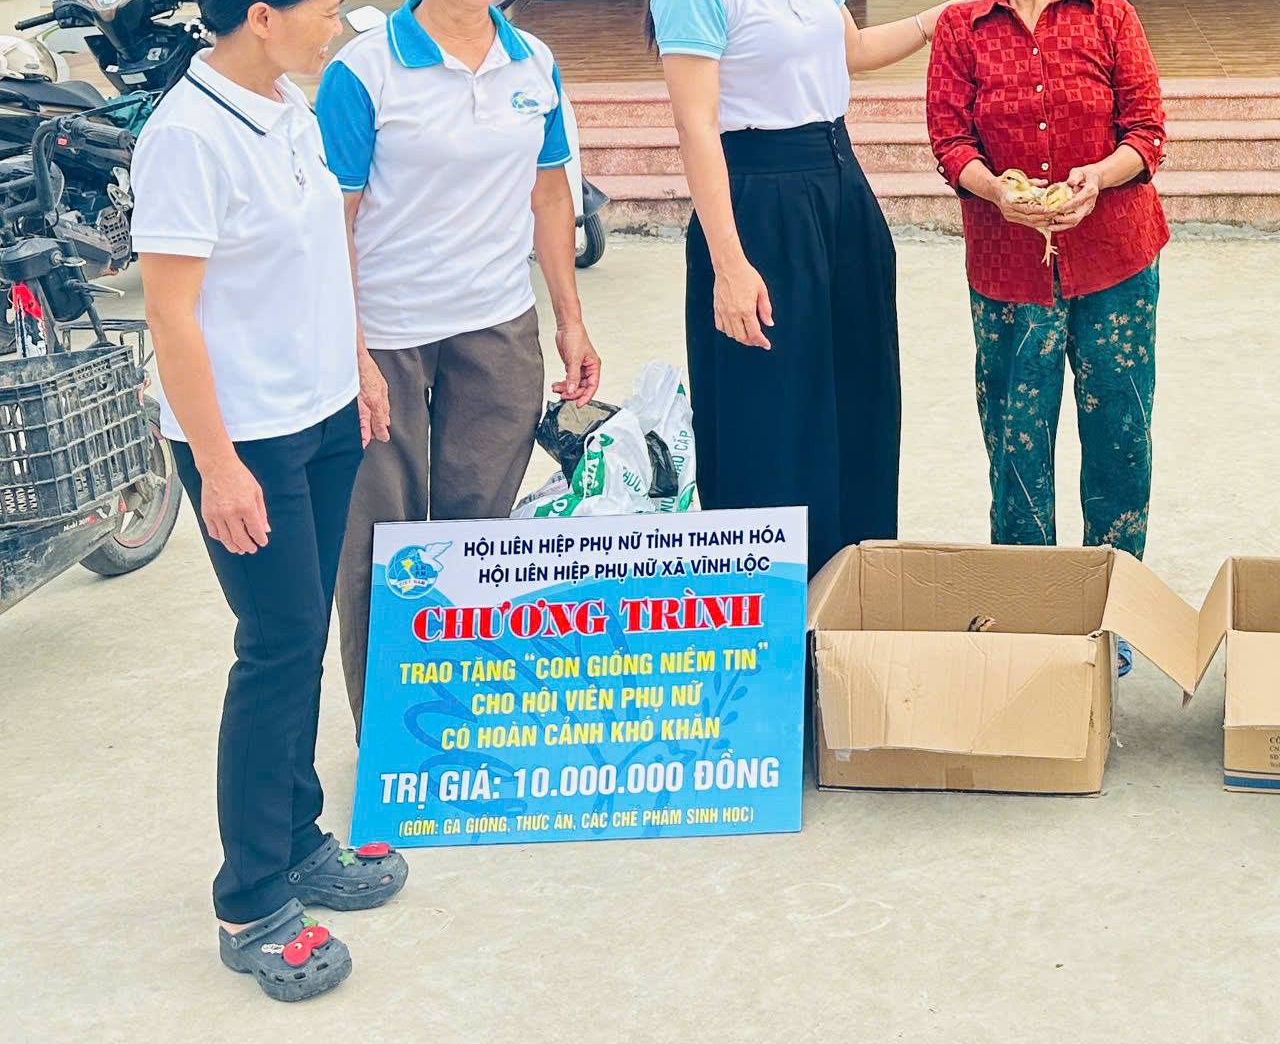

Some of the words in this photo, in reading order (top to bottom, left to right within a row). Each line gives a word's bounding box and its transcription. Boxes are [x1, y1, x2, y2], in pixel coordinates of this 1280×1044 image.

[464, 536, 495, 557] HỘI
[499, 535, 535, 555] LIÊN
[538, 533, 575, 557] HIỆP
[579, 535, 613, 556] PHỤ
[618, 531, 642, 551] NỮ
[646, 528, 683, 549] TỈNH
[688, 528, 745, 548] THANH
[749, 524, 786, 545] HÓA
[478, 563, 510, 588] HỘI
[515, 563, 549, 583] LIÊN
[553, 561, 590, 585] HIỆP
[594, 561, 629, 582] PHỤ
[633, 558, 658, 578] NỮ
[661, 557, 686, 576] XÃ
[690, 555, 731, 574] VĨNH
[736, 553, 771, 577] LỘC
[412, 599, 607, 642] CHƯƠNG
[620, 588, 764, 634] TRÌNH
[400, 661, 453, 684] TRAO
[460, 656, 516, 687] TẶNG
[587, 646, 653, 678] GIỐNG
[660, 644, 716, 673] NIỀM
[471, 692, 515, 716] CHO
[521, 686, 559, 718] HỘI
[565, 684, 614, 712] VIÊN
[620, 686, 665, 714] PHỤ
[670, 679, 704, 708] NỮ
[441, 722, 471, 751] CÓ
[476, 720, 538, 749] HOÀN
[544, 716, 605, 746] CẢNH
[610, 715, 654, 743] KHÓ
[660, 712, 722, 741] KHĂN
[380, 771, 429, 810] TRỊ
[438, 762, 501, 803] GIÁ:
[513, 760, 684, 799] 10.000.000
[693, 747, 780, 792] ĐỒNG
[581, 808, 608, 829] CÁC
[612, 806, 639, 827] CHẾ
[642, 803, 683, 826] PHẨM
[686, 807, 719, 825] SINH
[722, 806, 755, 826] HỌC)
